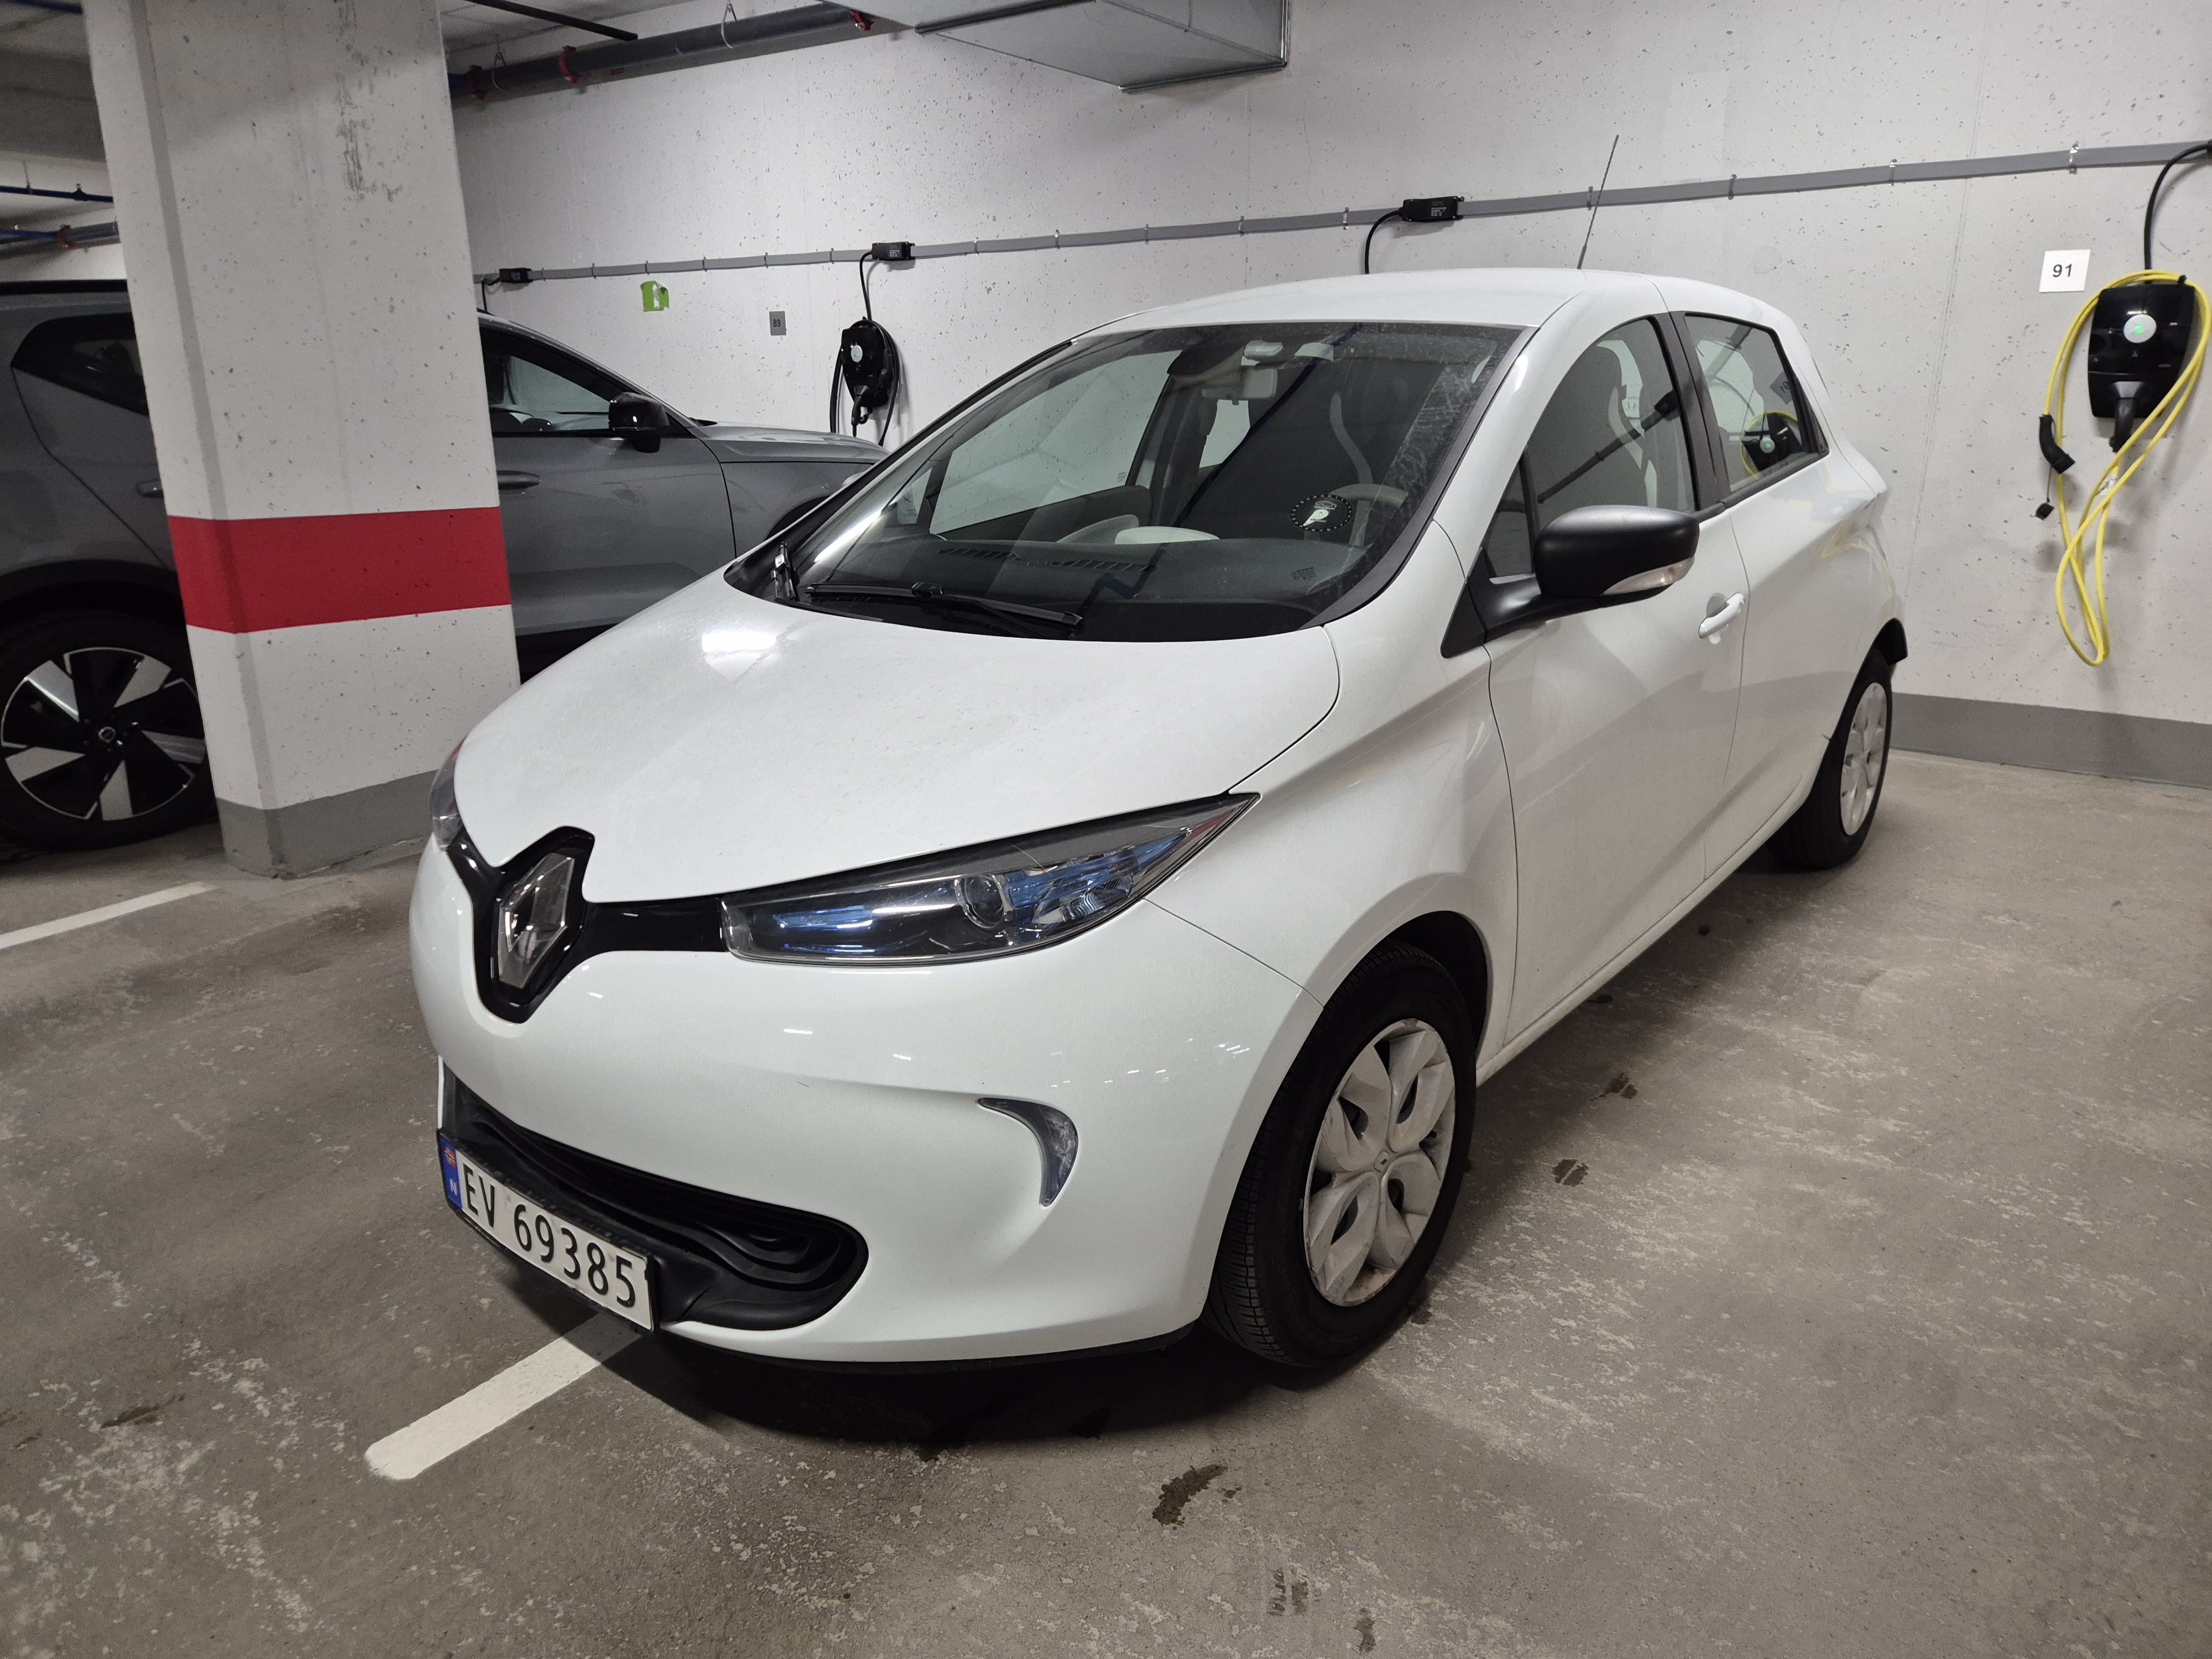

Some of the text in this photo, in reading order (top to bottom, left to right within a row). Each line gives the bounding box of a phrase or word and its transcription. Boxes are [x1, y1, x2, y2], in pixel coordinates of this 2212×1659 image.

[2052, 263, 2072, 278] 91
[773, 319, 781, 327] 89
[449, 1178, 458, 1196] N
[462, 1163, 636, 1308] EV 69385
